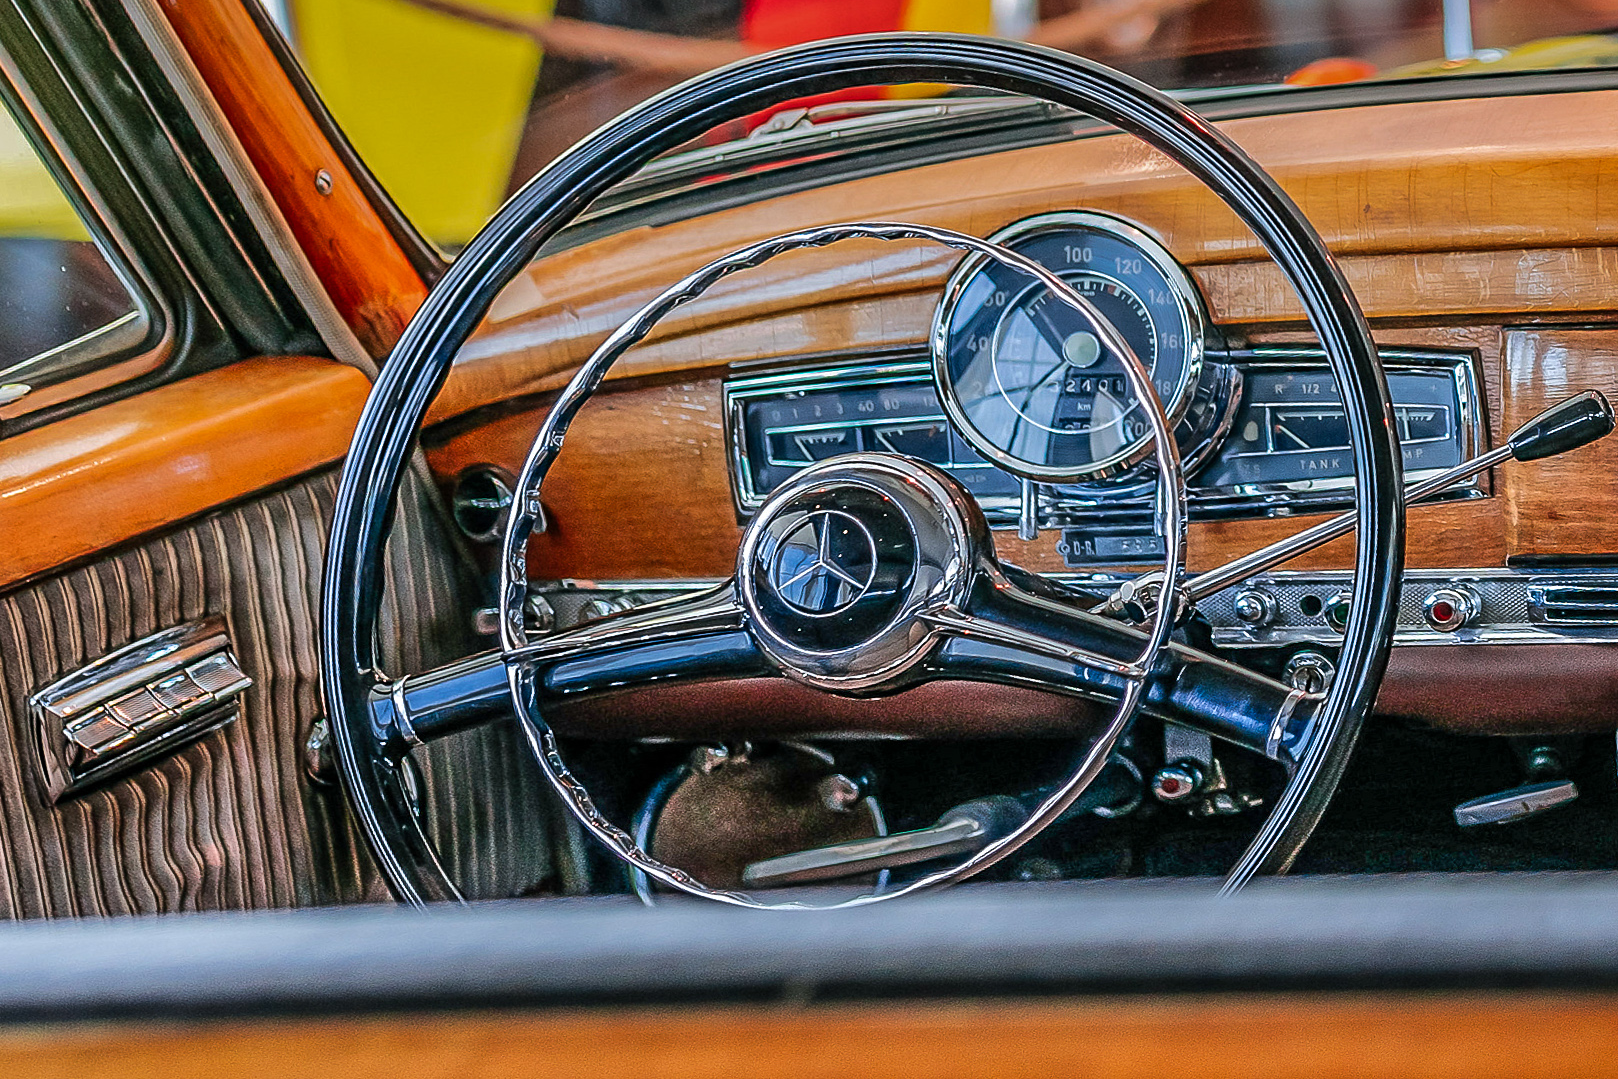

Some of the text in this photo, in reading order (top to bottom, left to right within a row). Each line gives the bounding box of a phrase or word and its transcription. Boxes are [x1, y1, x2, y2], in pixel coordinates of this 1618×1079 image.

[1063, 245, 1093, 263] 100
[1114, 257, 1142, 274] 120
[966, 334, 988, 352] 40
[1155, 379, 1175, 396] 18
[1275, 383, 1283, 394] R
[1302, 383, 1320, 394] 1/2
[793, 407, 798, 419] 1
[858, 399, 875, 412] 40
[883, 398, 900, 411] 80
[1300, 458, 1341, 470] TANK
